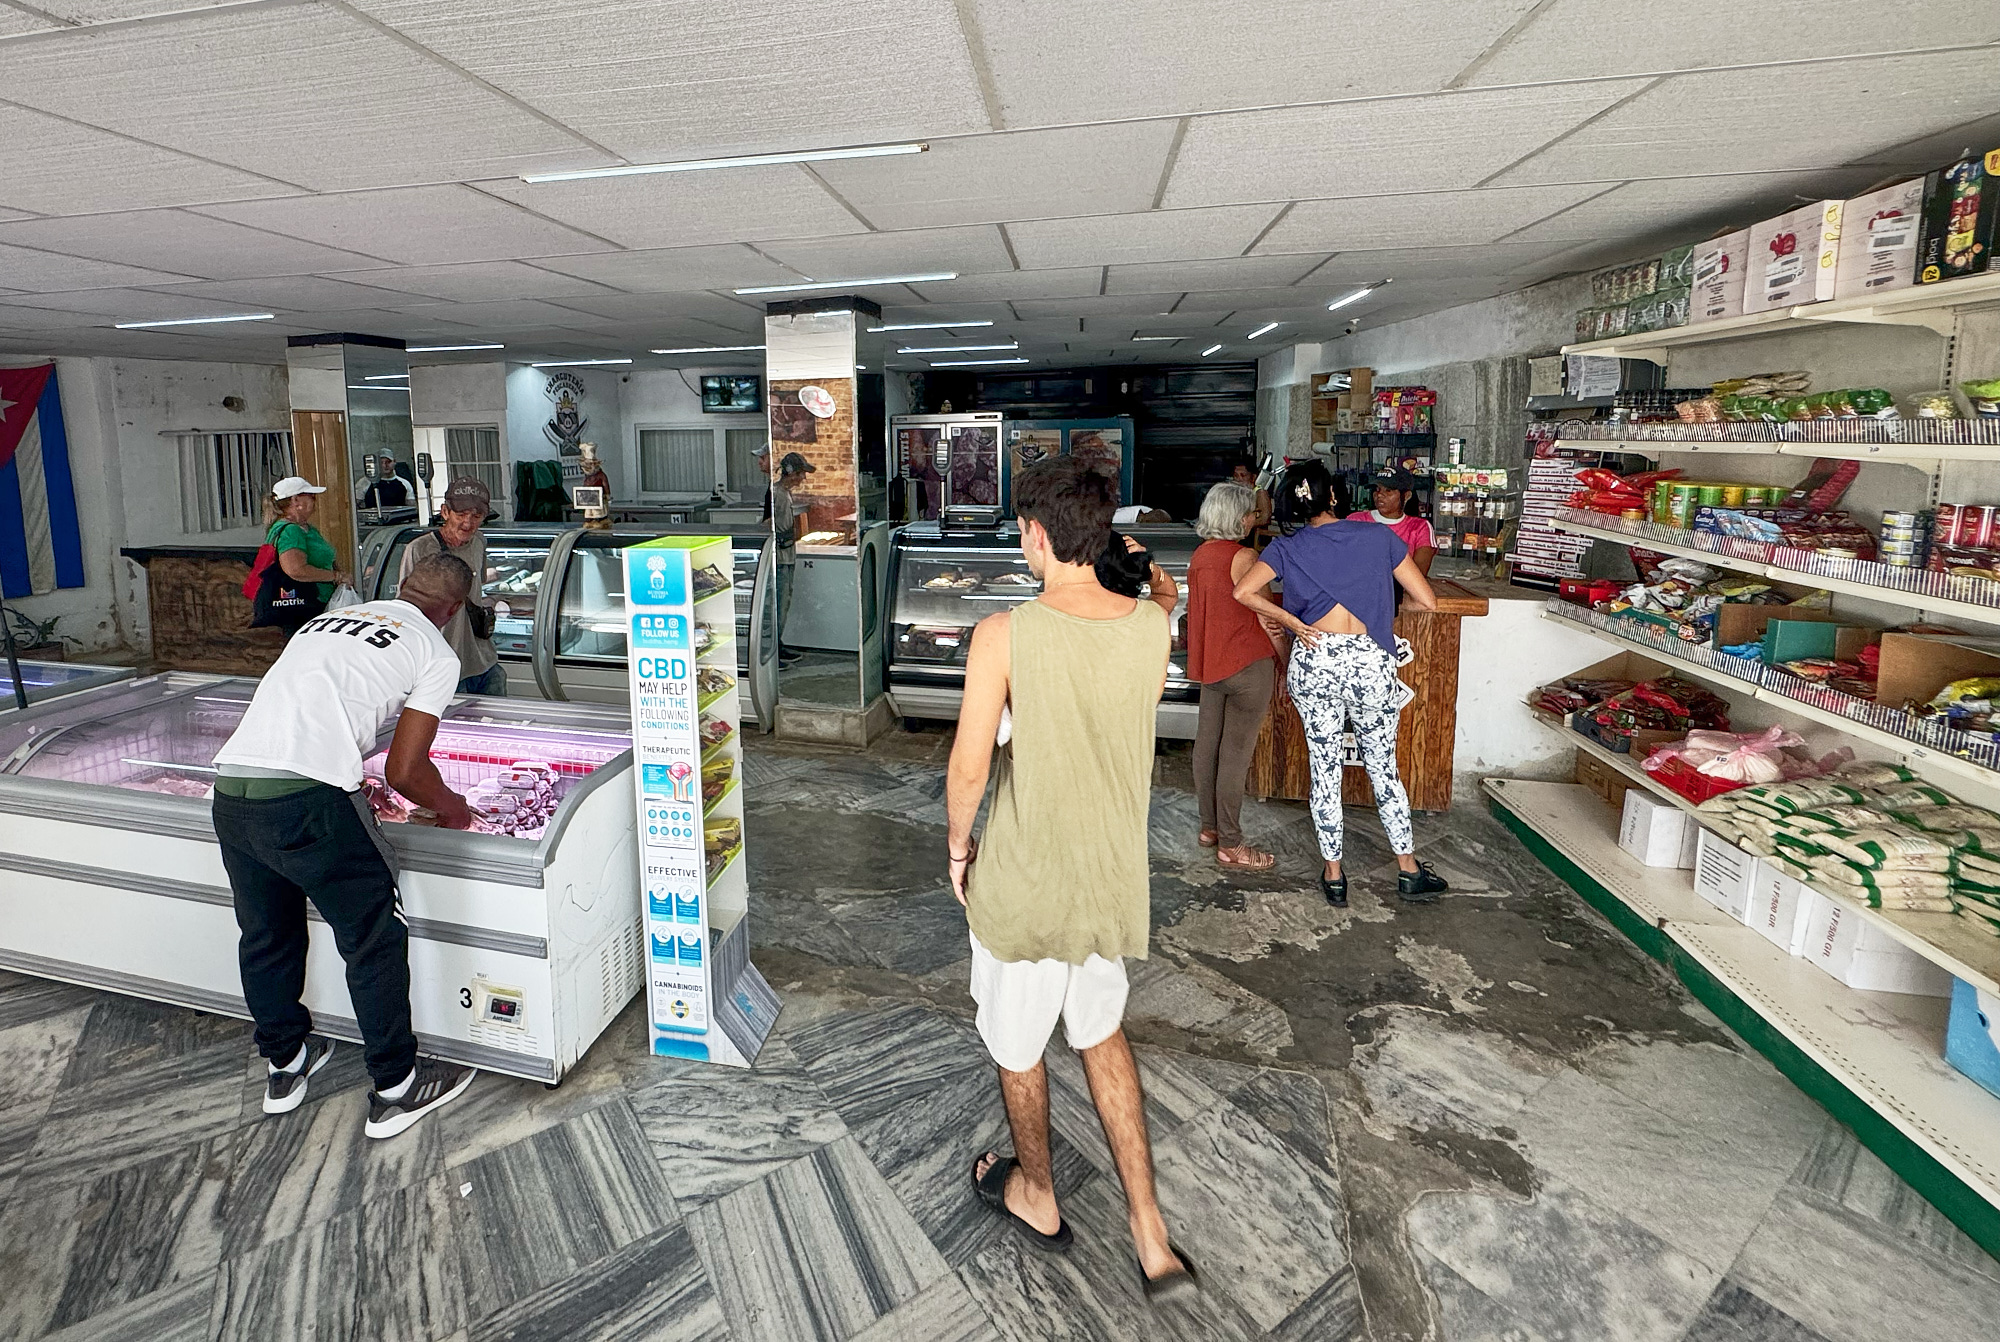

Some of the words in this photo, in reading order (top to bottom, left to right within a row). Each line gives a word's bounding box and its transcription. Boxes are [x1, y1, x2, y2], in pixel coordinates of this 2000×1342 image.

[272, 598, 305, 607] matrix
[641, 629, 669, 638] FOLLOW
[670, 630, 680, 638] US
[638, 657, 687, 680] CBD
[639, 681, 659, 694] MAY
[662, 682, 688, 696] HELP
[640, 696, 666, 708] WITH
[668, 697, 689, 709] THE
[640, 708, 690, 721] FOLLOWING
[641, 720, 690, 731] CONDITIONS
[642, 745, 691, 756] THERAPEUTIC
[648, 866, 698, 878] EFFECTIVE
[1774, 880, 1781, 891] 12
[1832, 907, 1841, 918] 12
[1826, 917, 1839, 943] F/500
[654, 980, 704, 993] CANNABINOIDS
[460, 987, 473, 1009] 3
[667, 989, 680, 997] THE
[681, 991, 700, 999] BODY
